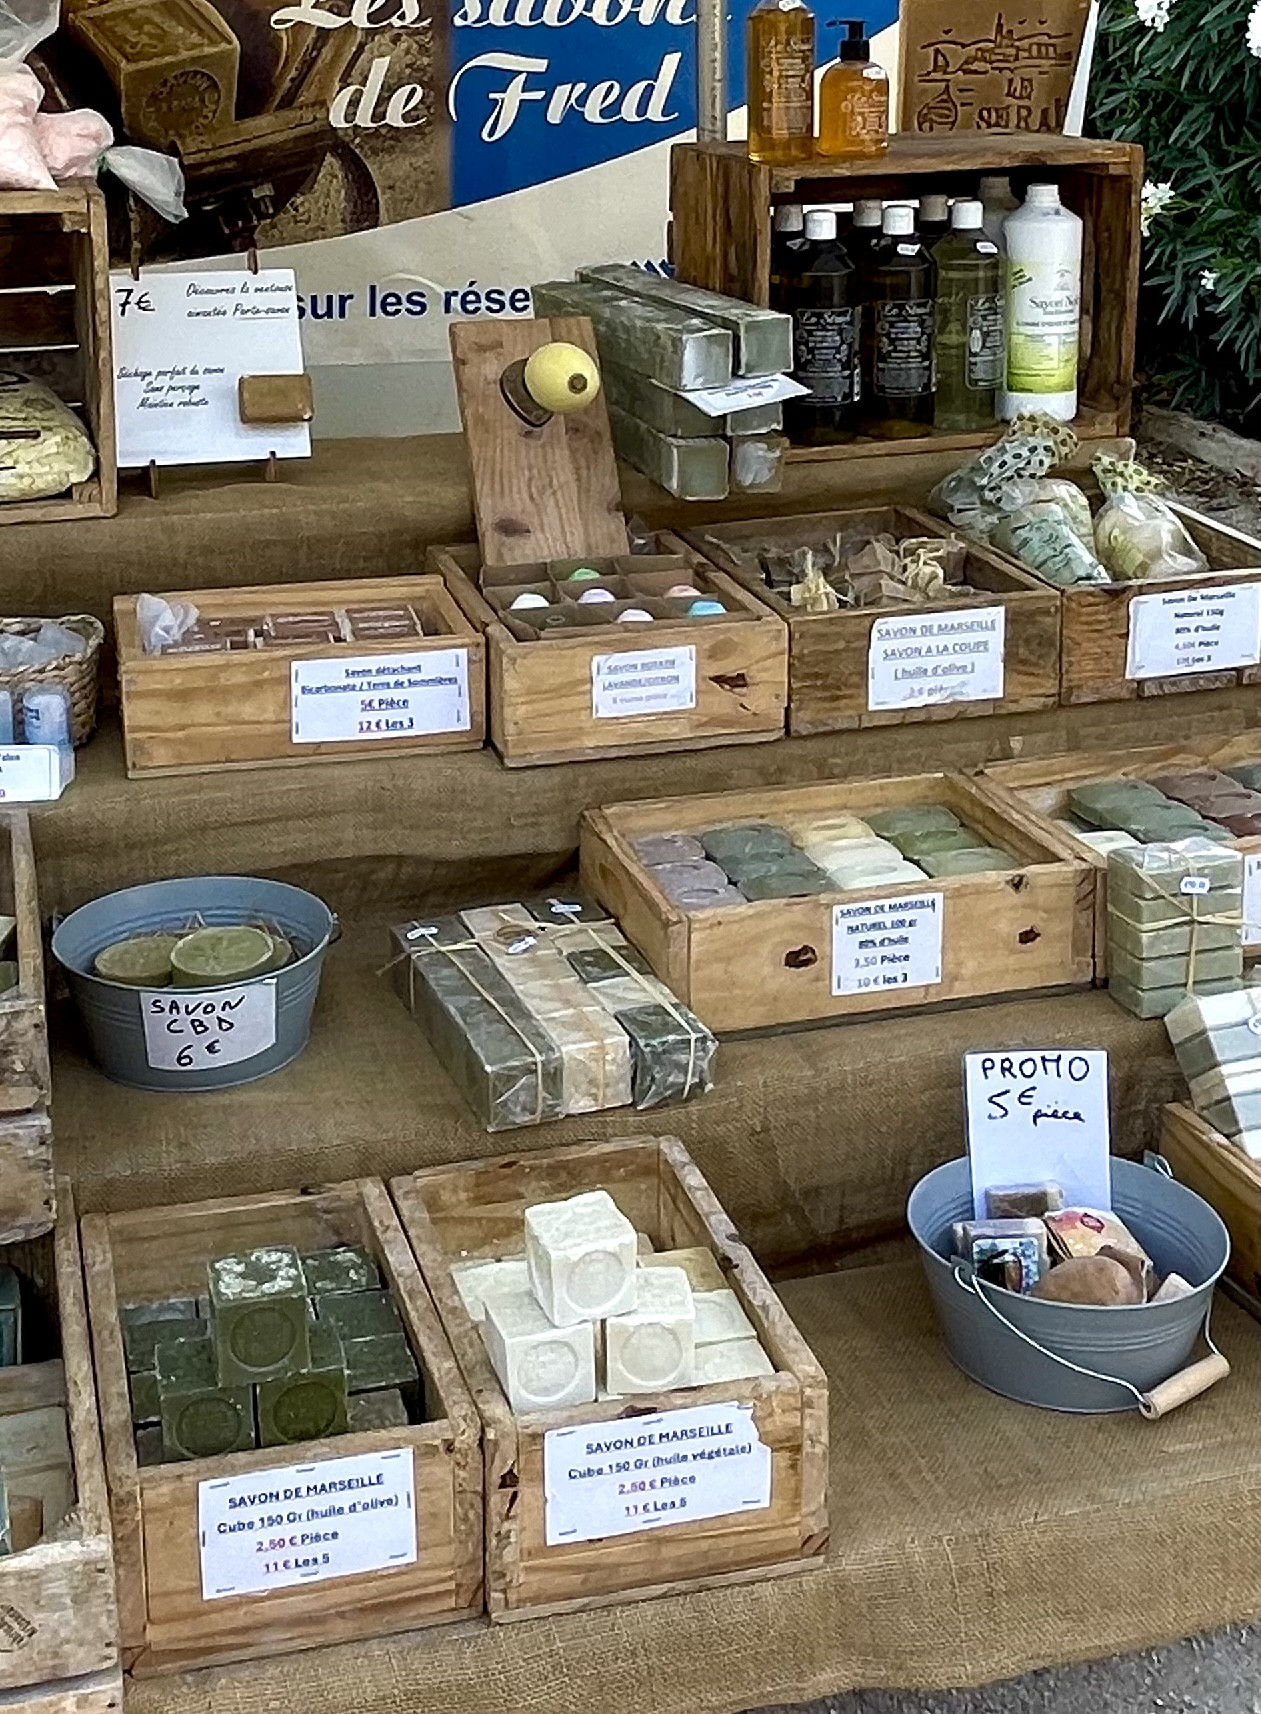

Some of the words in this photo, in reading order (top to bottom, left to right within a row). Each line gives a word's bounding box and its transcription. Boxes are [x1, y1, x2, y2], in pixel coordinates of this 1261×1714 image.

[453, 0, 732, 28] savon
[328, 56, 428, 129] de
[448, 52, 681, 142] Fred
[368, 284, 428, 318] les
[877, 625, 917, 639] SAVON
[920, 623, 935, 636] DE
[937, 619, 997, 635] MARSEILLE
[882, 646, 923, 661] SAVON
[925, 644, 934, 656] A
[936, 643, 950, 656] LA
[952, 640, 990, 654] COUPE
[345, 667, 373, 679] Savon
[378, 697, 410, 711] Pièce
[407, 716, 415, 730] 3
[839, 905, 872, 919] SAVON
[874, 903, 886, 915] DE
[846, 920, 888, 935] NATUREL
[880, 953, 910, 966] Pièce
[882, 973, 899, 985] les
[901, 972, 908, 984] 3
[150, 994, 247, 1016] SAVON
[166, 1014, 235, 1036] CBD
[176, 1043, 194, 1067] 6
[205, 1038, 222, 1055] €
[981, 1053, 1090, 1082] PROMO
[987, 1089, 1012, 1121] 5
[1017, 1085, 1038, 1106] €
[584, 1436, 635, 1456] SAVON
[636, 1433, 656, 1447] DE
[658, 1422, 734, 1444] MARSEILLE
[567, 1465, 604, 1481] Cube
[607, 1459, 631, 1475] 150
[634, 1458, 650, 1470] Gr
[652, 1451, 689, 1469] (huile
[691, 1442, 753, 1463] végétale)
[228, 1490, 280, 1510] SAVON
[283, 1486, 303, 1500] DE
[306, 1472, 385, 1497] MARSEILLE
[649, 1478, 658, 1491] €
[659, 1473, 697, 1488] Pièce
[216, 1519, 255, 1535] Cube
[257, 1512, 284, 1530] 150
[286, 1510, 303, 1524] Gr
[305, 1503, 346, 1523] (huile
[347, 1493, 400, 1515] d'olive)
[623, 1503, 639, 1518] 11
[641, 1502, 651, 1514] €
[653, 1499, 677, 1513] Les
[678, 1496, 688, 1509] 5
[288, 1534, 298, 1547] €
[299, 1529, 341, 1546] Pièce
[263, 1559, 280, 1574] 11
[282, 1558, 292, 1570] €
[293, 1555, 319, 1570] Les
[321, 1552, 331, 1565] 5
